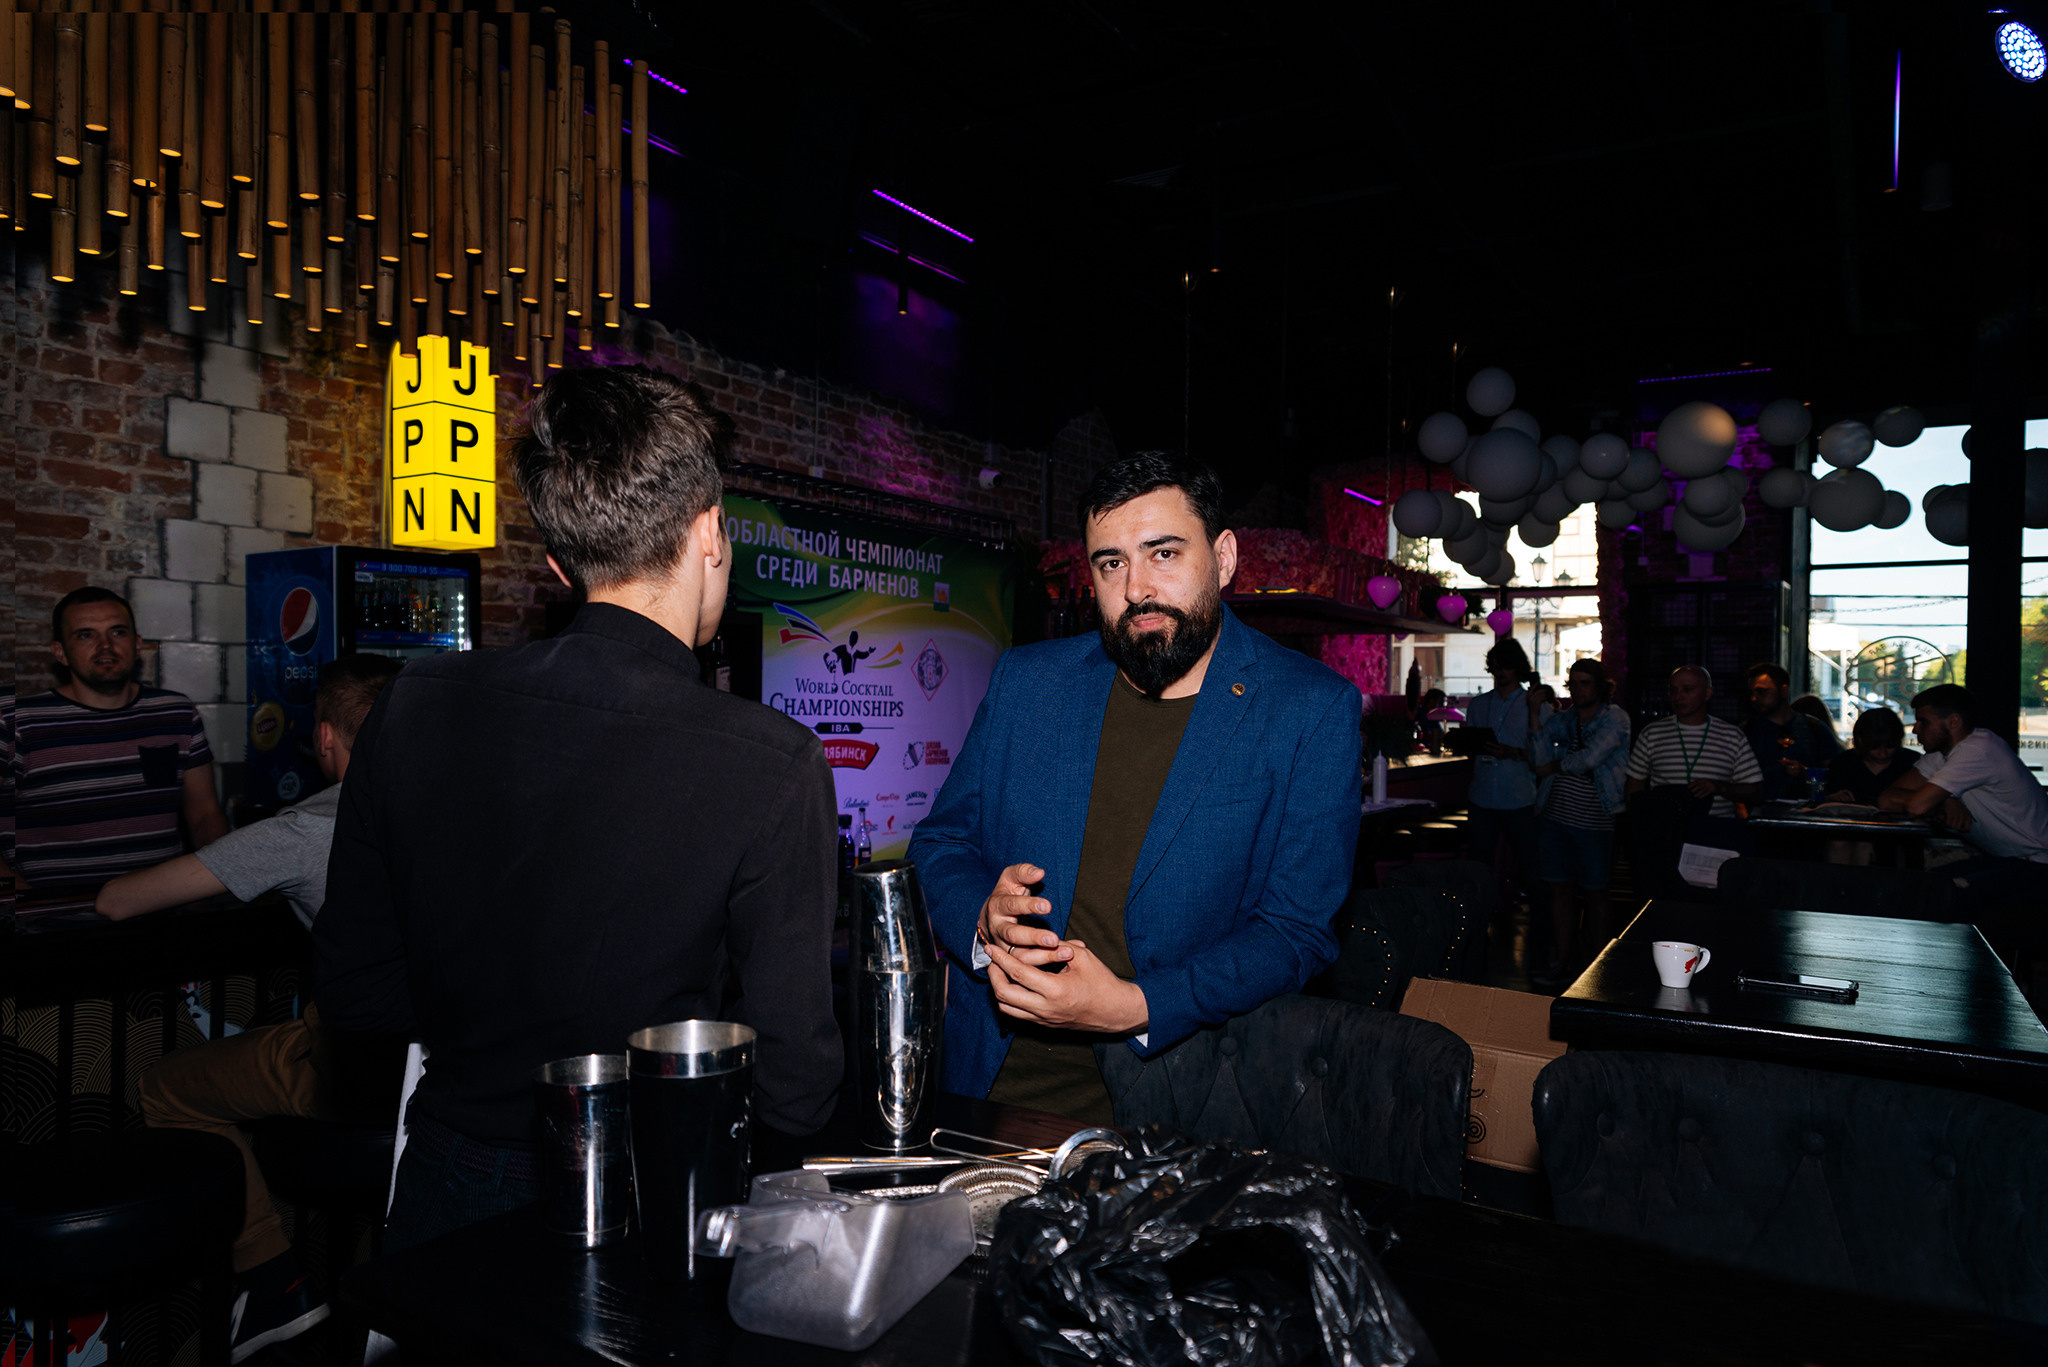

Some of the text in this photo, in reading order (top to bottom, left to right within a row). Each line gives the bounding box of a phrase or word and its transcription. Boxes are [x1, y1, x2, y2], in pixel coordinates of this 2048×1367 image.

[727, 516, 943, 575] ОБЛАСТНОЙ ЧЕМПИОНАТ
[756, 554, 919, 599] СРЕДИ БАРМЕНОВ
[284, 664, 318, 684] pepsi
[795, 678, 894, 697] WORLD COCKTAIL
[769, 692, 904, 718] CHAMPIONSHIPS
[831, 724, 850, 733] IBA
[824, 746, 867, 762] ЛЯБИНСК
